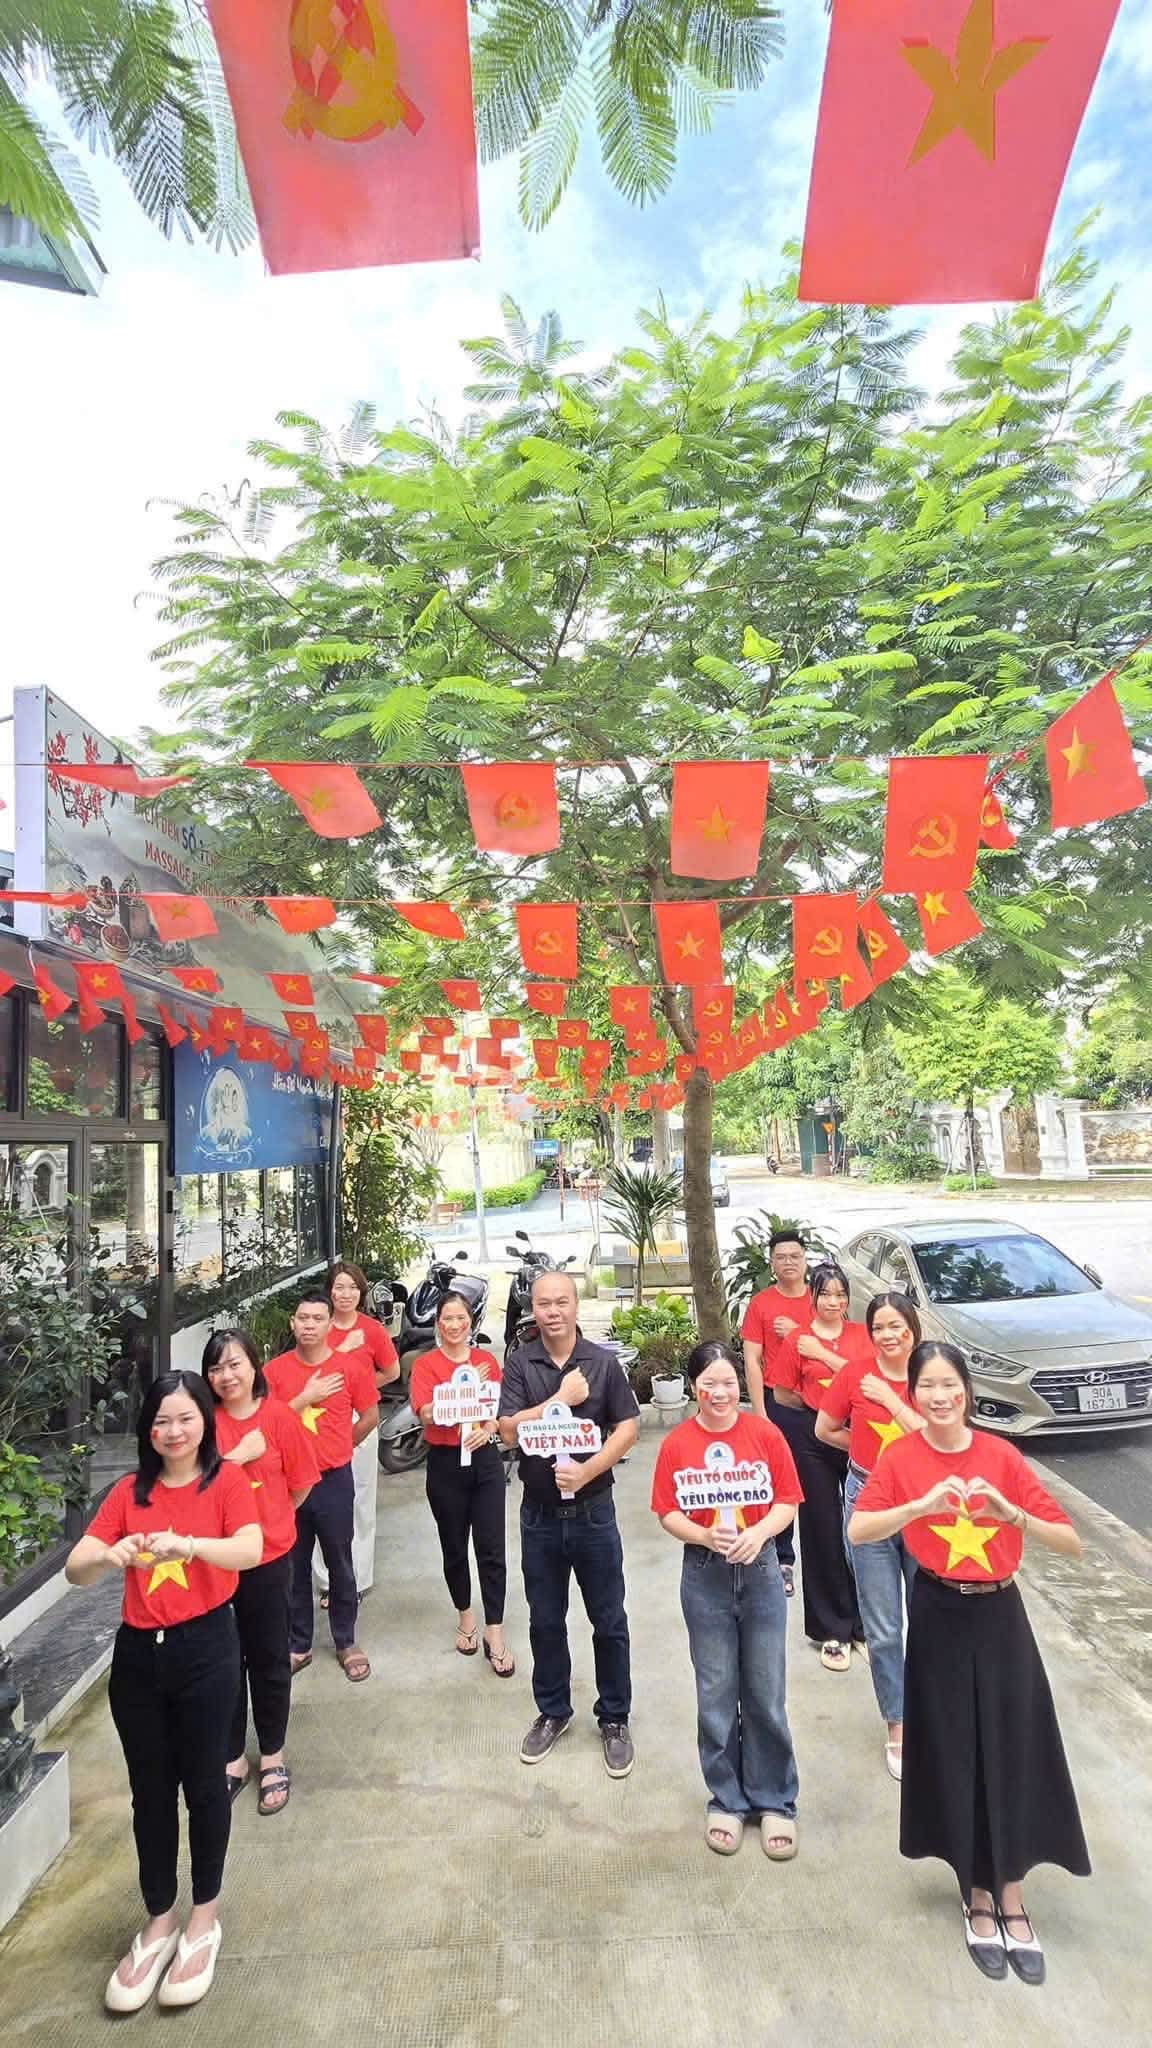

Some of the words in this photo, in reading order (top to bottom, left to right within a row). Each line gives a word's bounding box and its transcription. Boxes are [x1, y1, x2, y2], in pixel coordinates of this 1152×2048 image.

[524, 1433, 557, 1452] VIỆT
[562, 1434, 595, 1448] NAM
[678, 1471, 702, 1486] YÊU
[723, 1464, 757, 1482] QUỐC
[681, 1492, 705, 1506] YÊU
[707, 1487, 741, 1505] ĐỒNG
